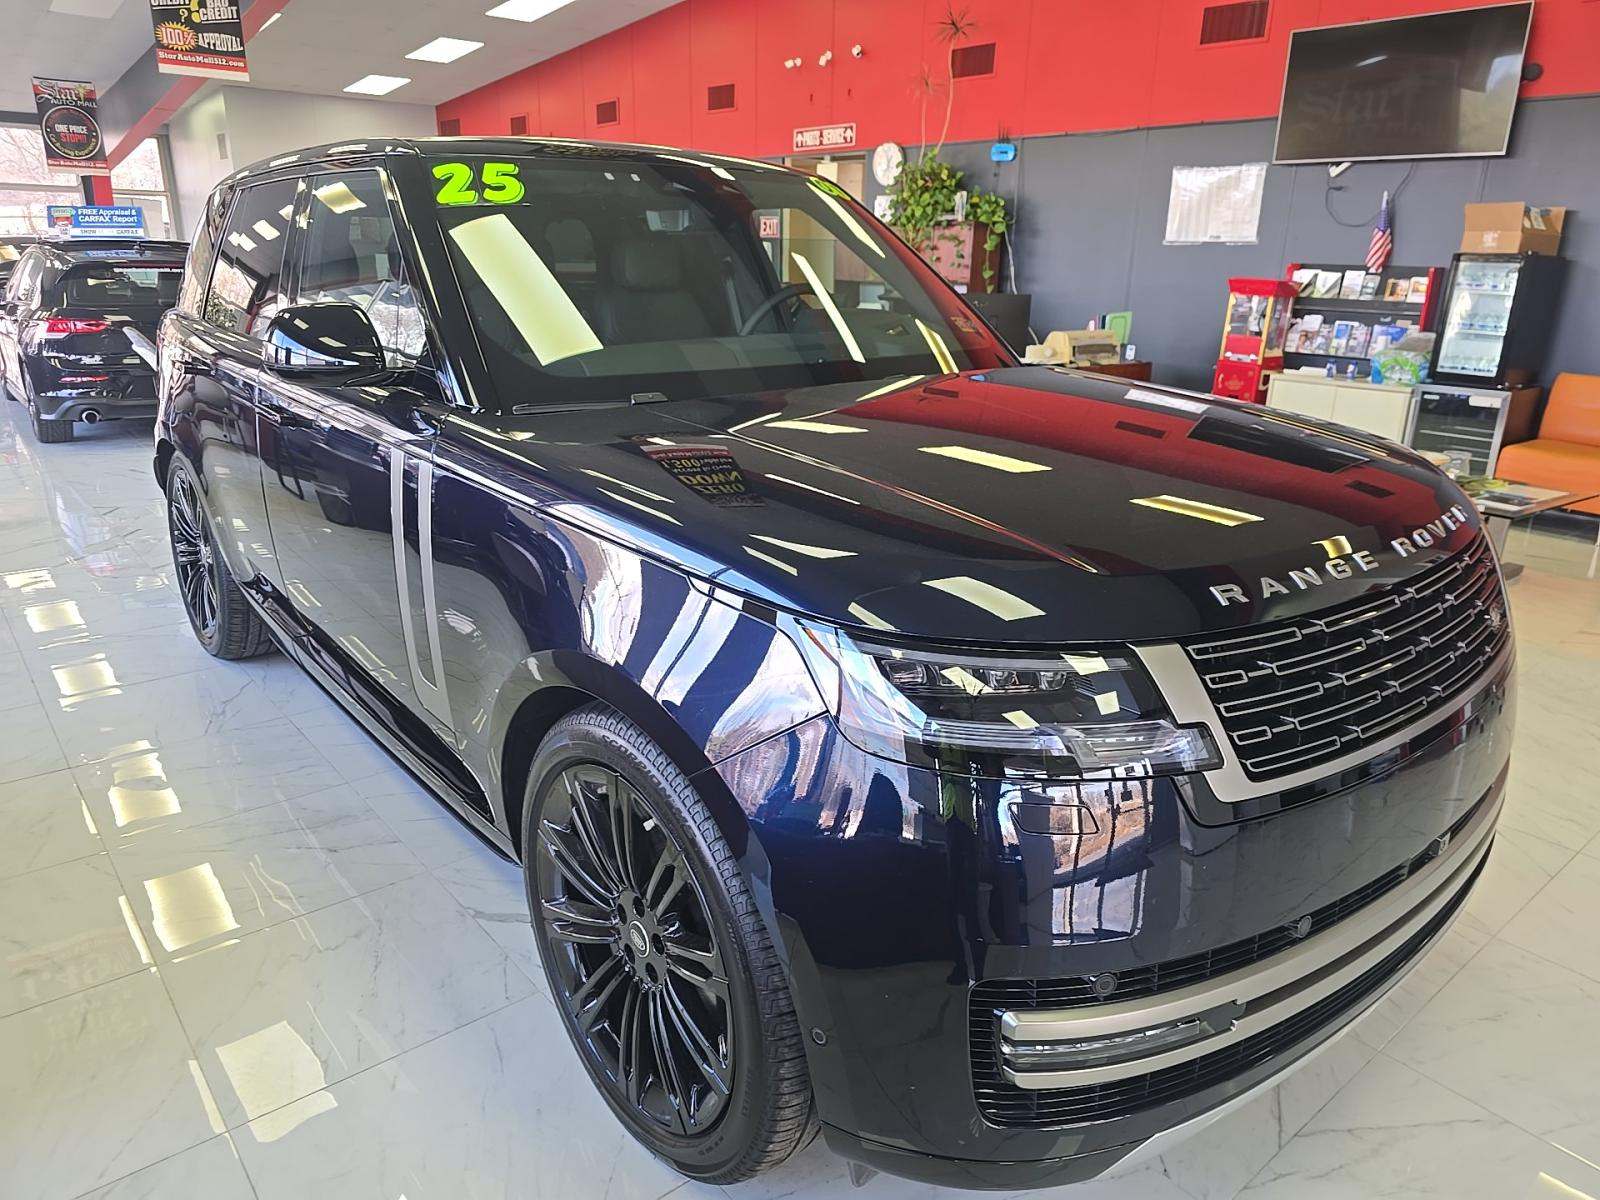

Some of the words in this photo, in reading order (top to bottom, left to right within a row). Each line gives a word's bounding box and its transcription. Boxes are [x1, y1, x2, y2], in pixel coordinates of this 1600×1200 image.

[200, 7, 237, 20] CREDIT
[160, 27, 195, 47] 100%
[198, 32, 243, 51] APPROVAL
[37, 80, 80, 102] Star
[77, 100, 97, 108] MALL
[55, 124, 69, 133] ONE
[432, 162, 525, 205] 25
[79, 215, 111, 223] CARFAX
[113, 215, 137, 224] Report
[99, 208, 131, 217] Appraisal
[1209, 549, 1380, 607] RANGE
[1391, 503, 1469, 558] ROVER
